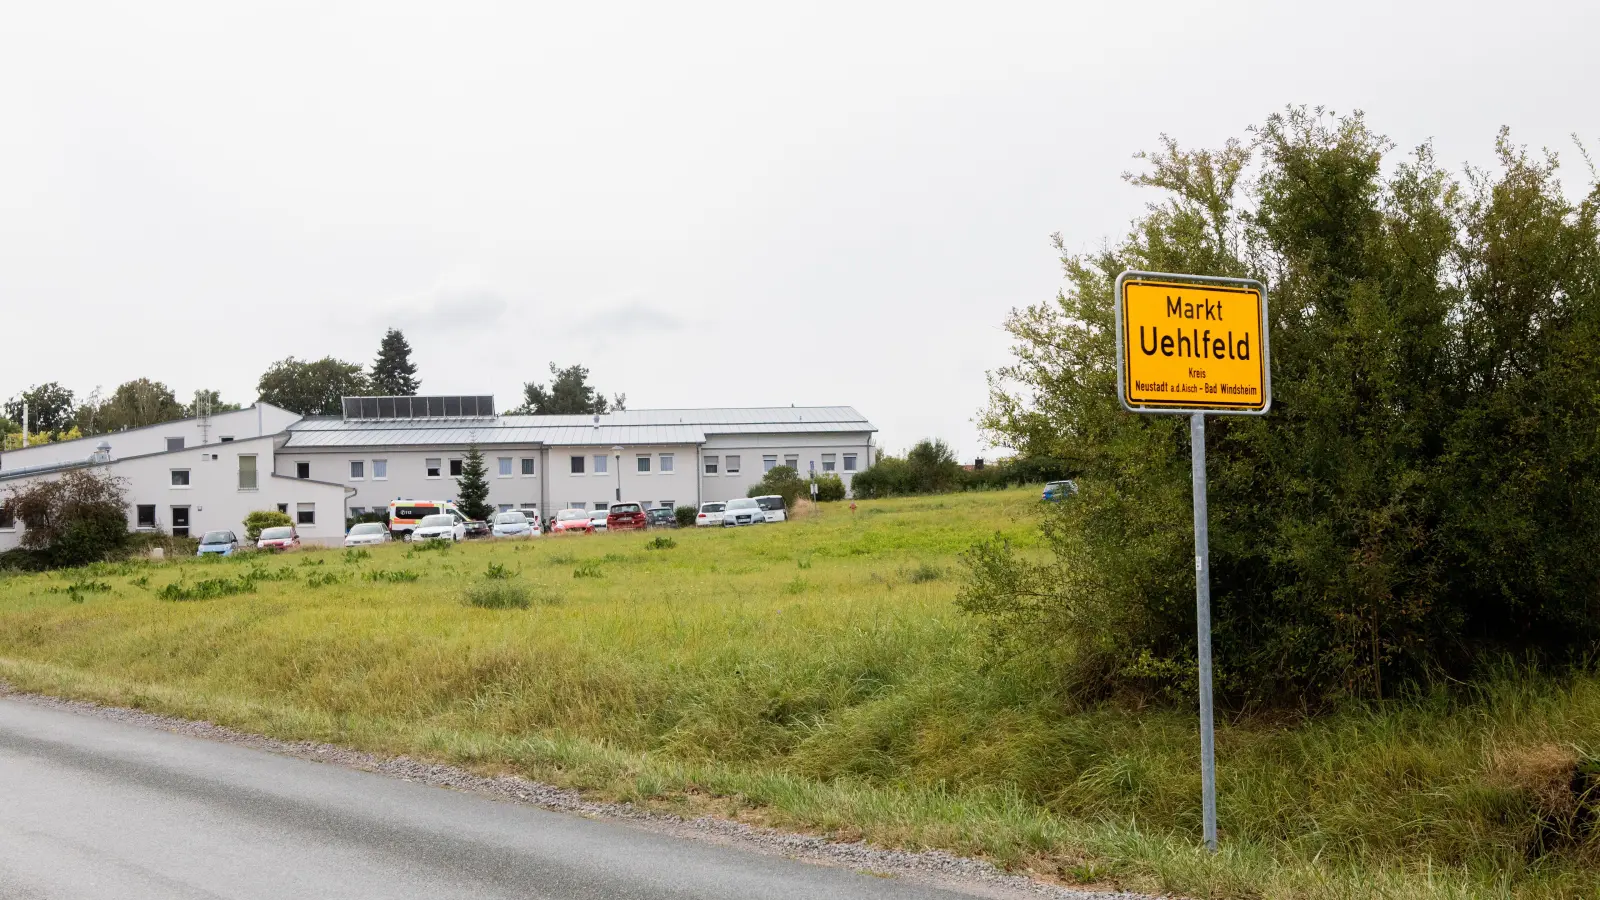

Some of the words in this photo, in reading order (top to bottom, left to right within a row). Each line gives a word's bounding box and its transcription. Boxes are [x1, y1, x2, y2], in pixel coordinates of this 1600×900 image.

[1167, 296, 1222, 321] Markt
[1140, 326, 1250, 361] Uehlfeld
[1188, 367, 1206, 379] Kreis
[1135, 380, 1168, 393] Neustadt
[1205, 383, 1218, 394] Bad
[1220, 384, 1257, 395] Windsheim
